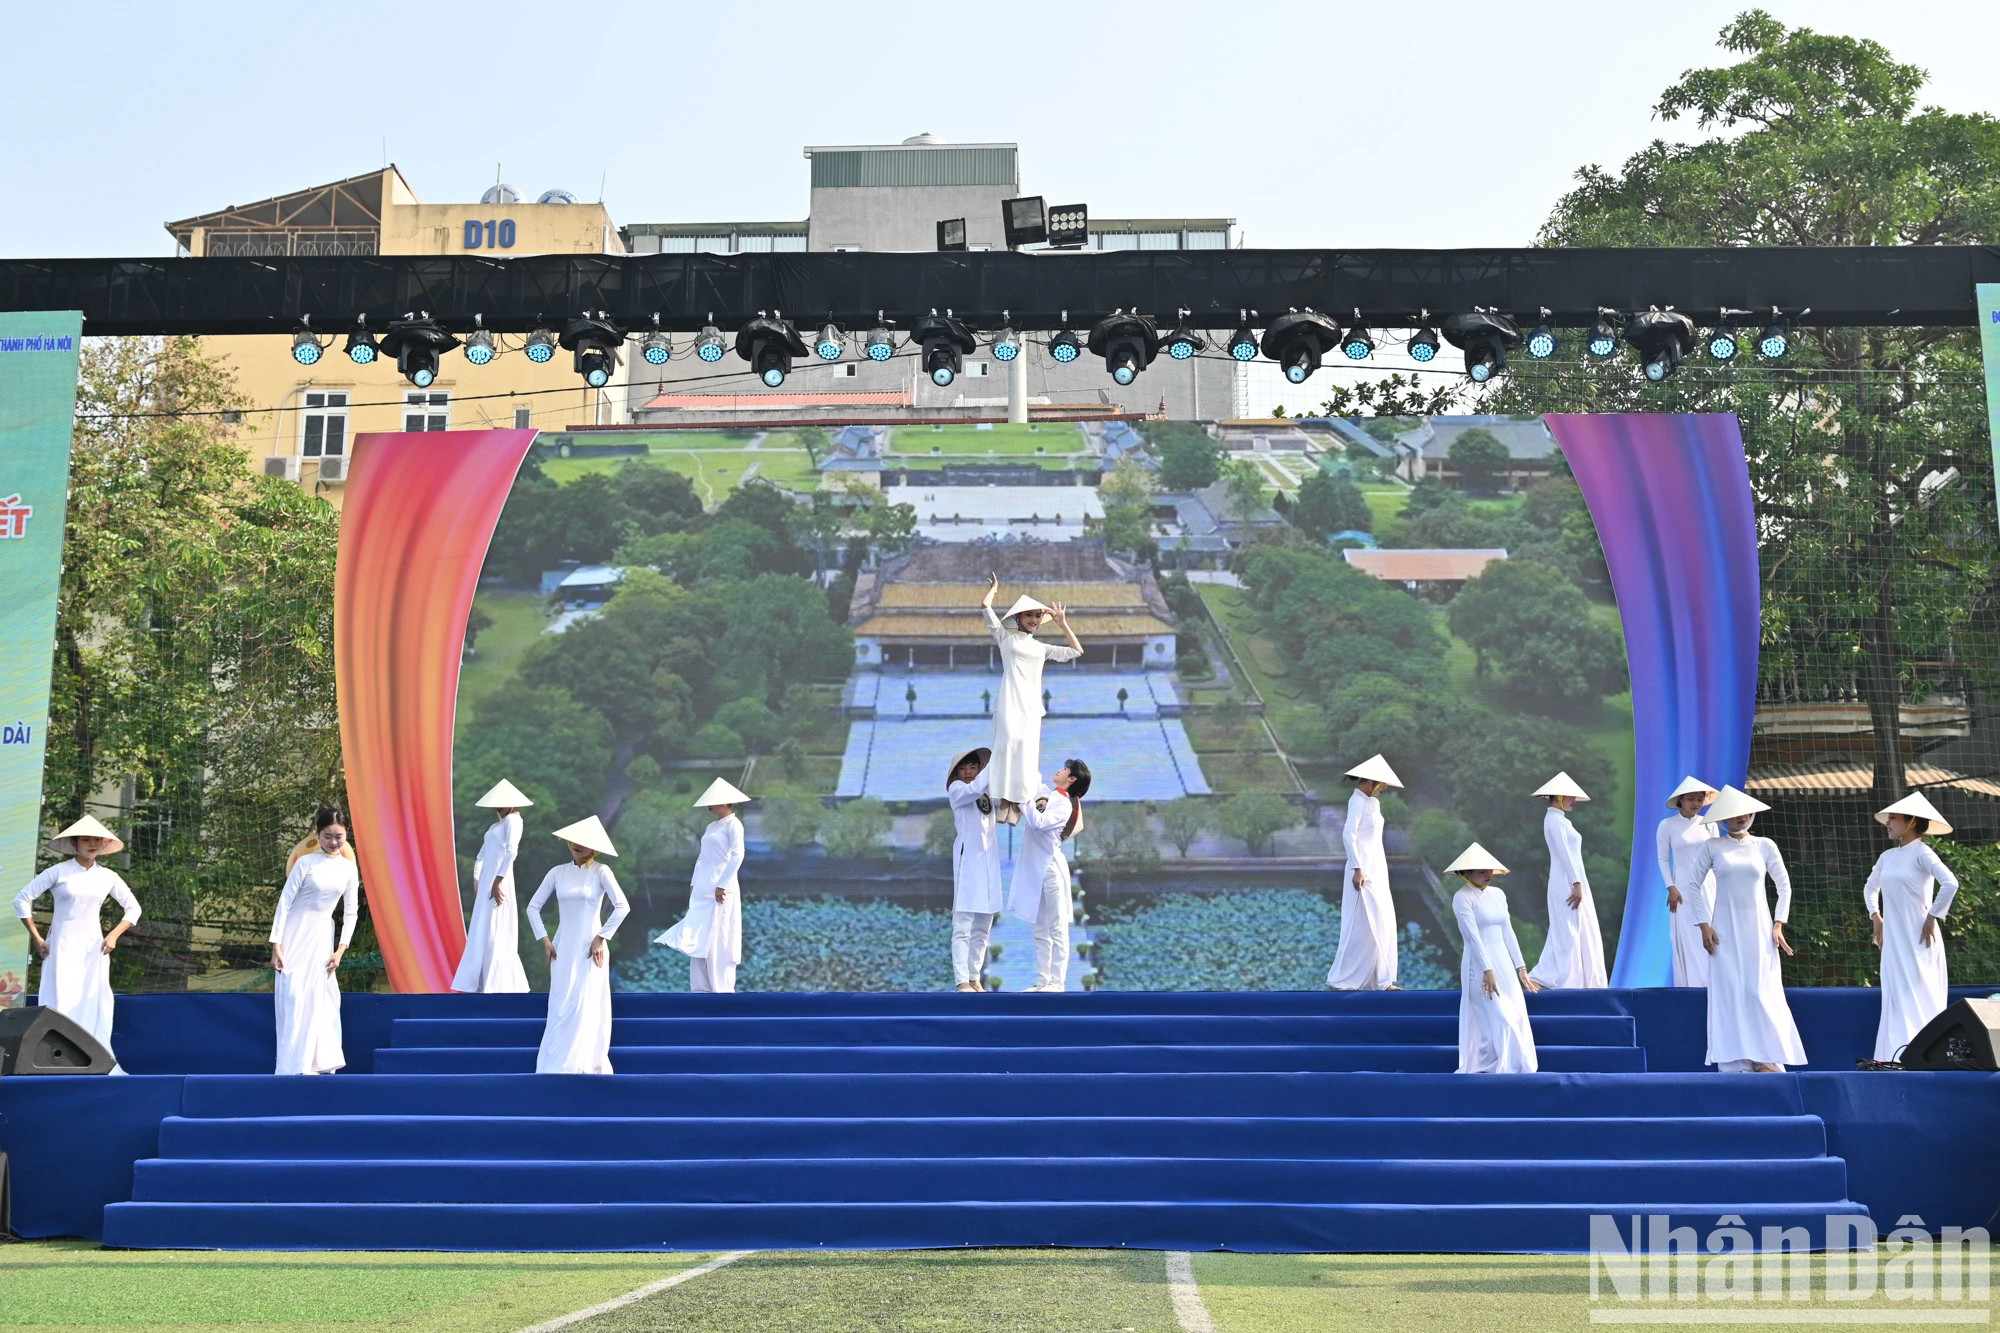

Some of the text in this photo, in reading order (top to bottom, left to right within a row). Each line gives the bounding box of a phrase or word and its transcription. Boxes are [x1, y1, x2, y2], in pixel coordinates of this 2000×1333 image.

[464, 219, 516, 249] D10
[25, 333, 43, 351] PHỐ
[44, 335, 55, 351] HÀ
[57, 335, 73, 353] NỘI
[3, 721, 31, 744] DÀI
